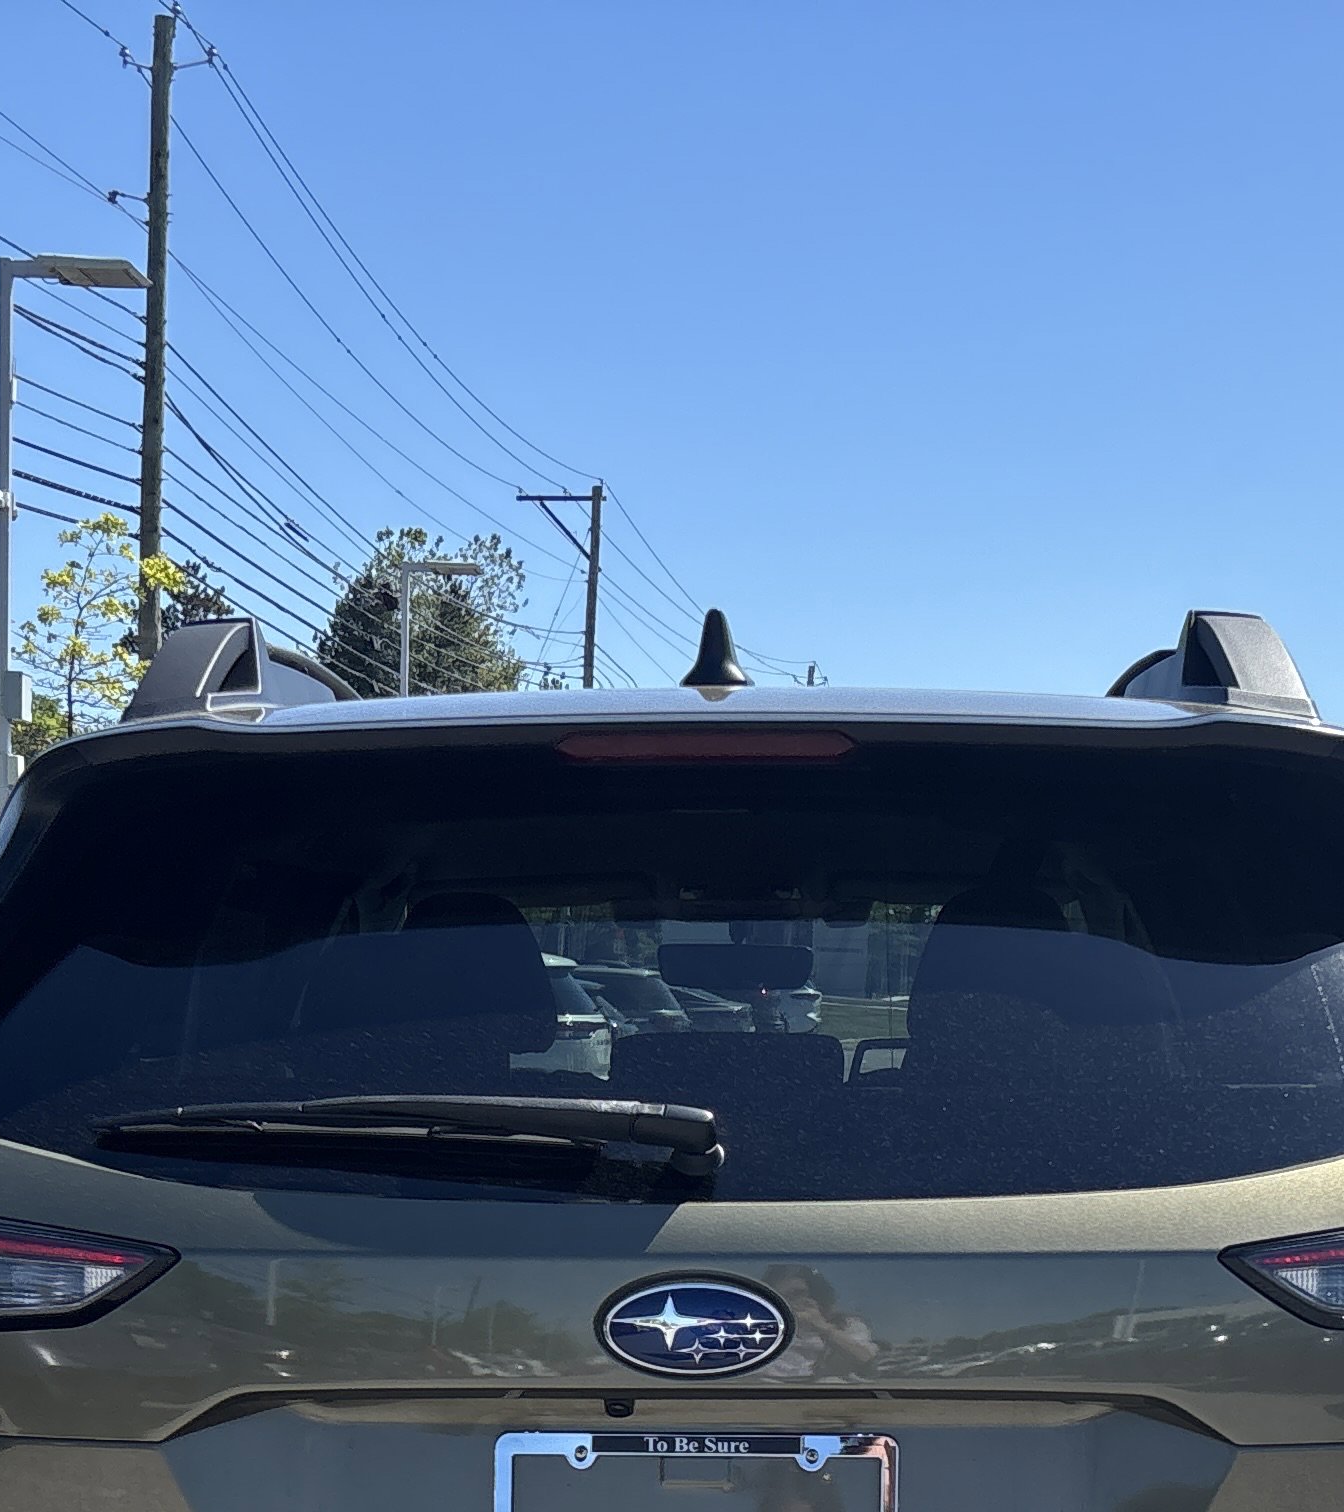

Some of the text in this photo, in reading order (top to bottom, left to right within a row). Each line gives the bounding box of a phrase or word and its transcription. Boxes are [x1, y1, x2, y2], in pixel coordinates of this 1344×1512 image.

[643, 1437, 750, 1454] To Be Sure
